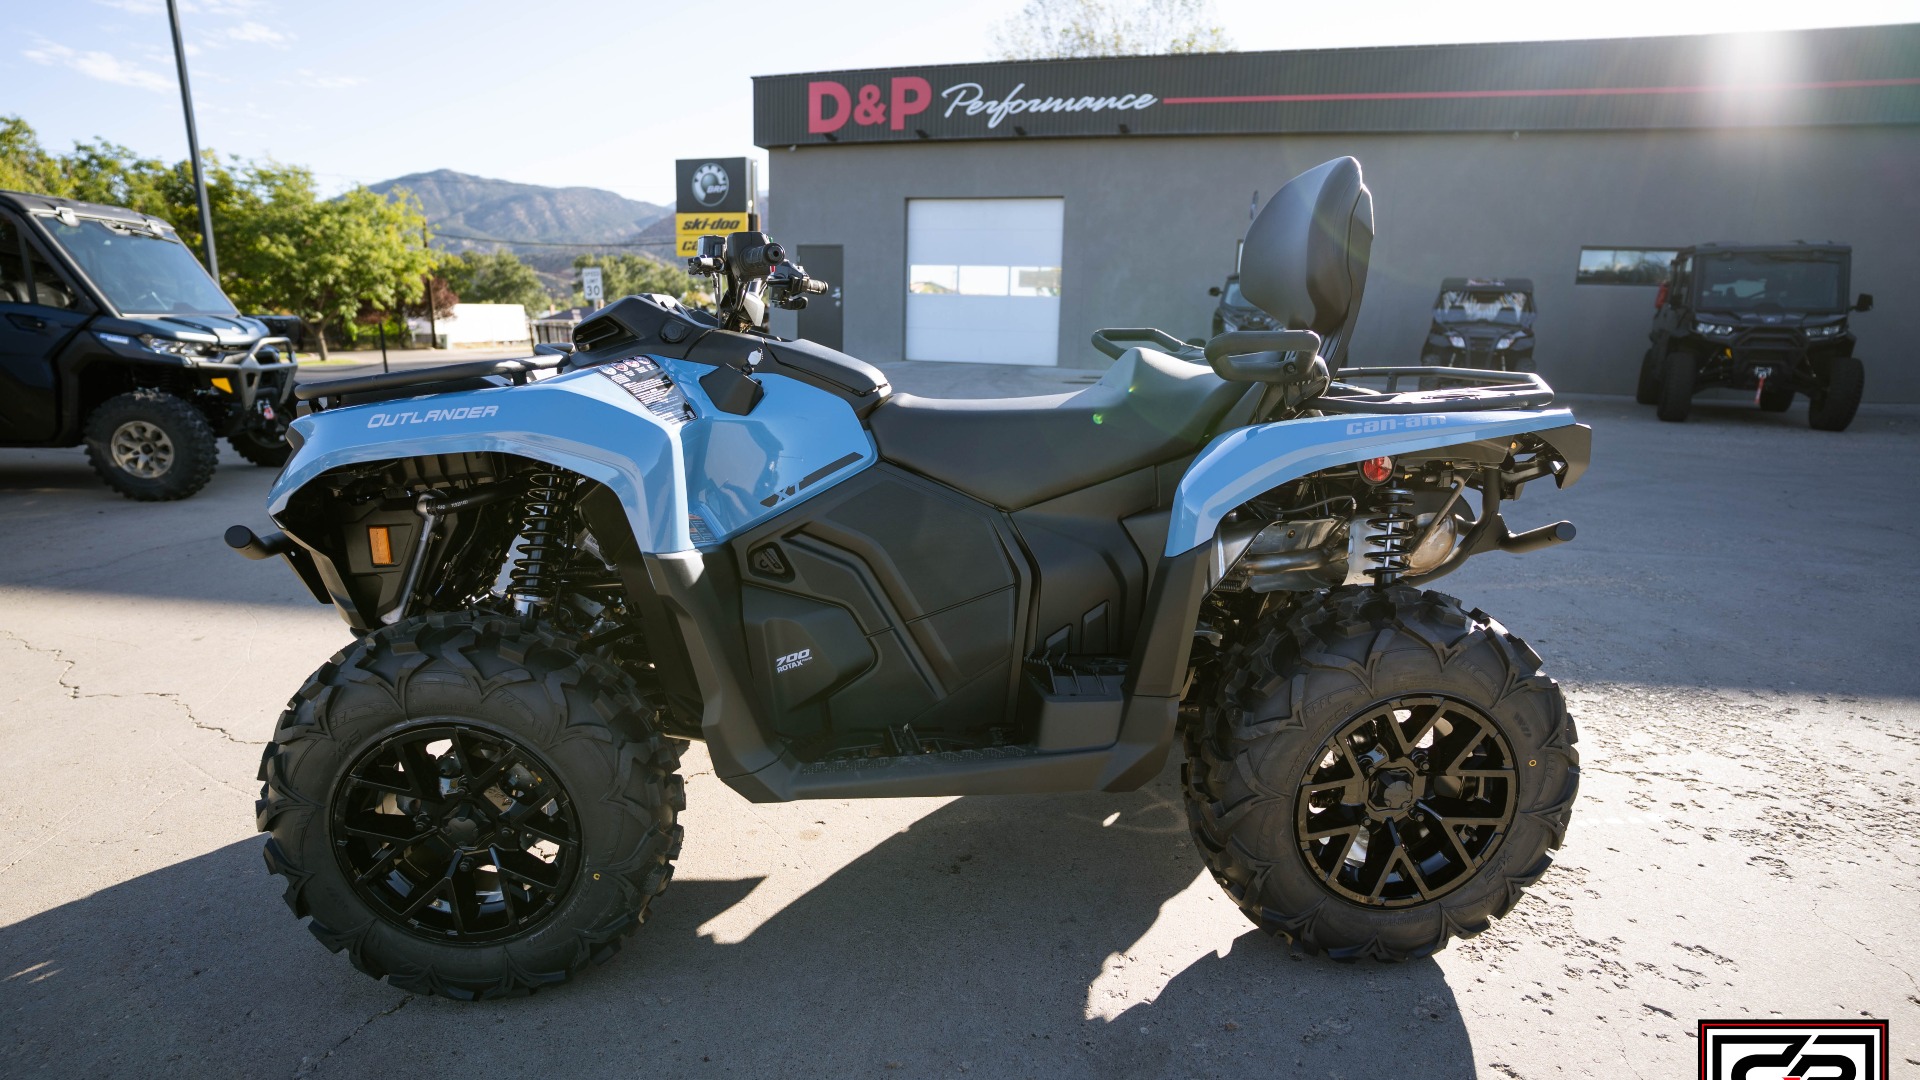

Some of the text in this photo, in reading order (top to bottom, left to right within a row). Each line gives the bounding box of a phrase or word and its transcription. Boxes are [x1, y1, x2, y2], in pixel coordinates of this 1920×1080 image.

[808, 76, 1158, 134] D&P Performance
[706, 185, 727, 194] BRP
[682, 217, 741, 231] ski-doo
[586, 284, 601, 297] 30
[367, 405, 499, 429] OUTLANDER
[1346, 415, 1447, 436] can-am
[776, 648, 810, 667] 700
[776, 659, 804, 674] ROTAX
